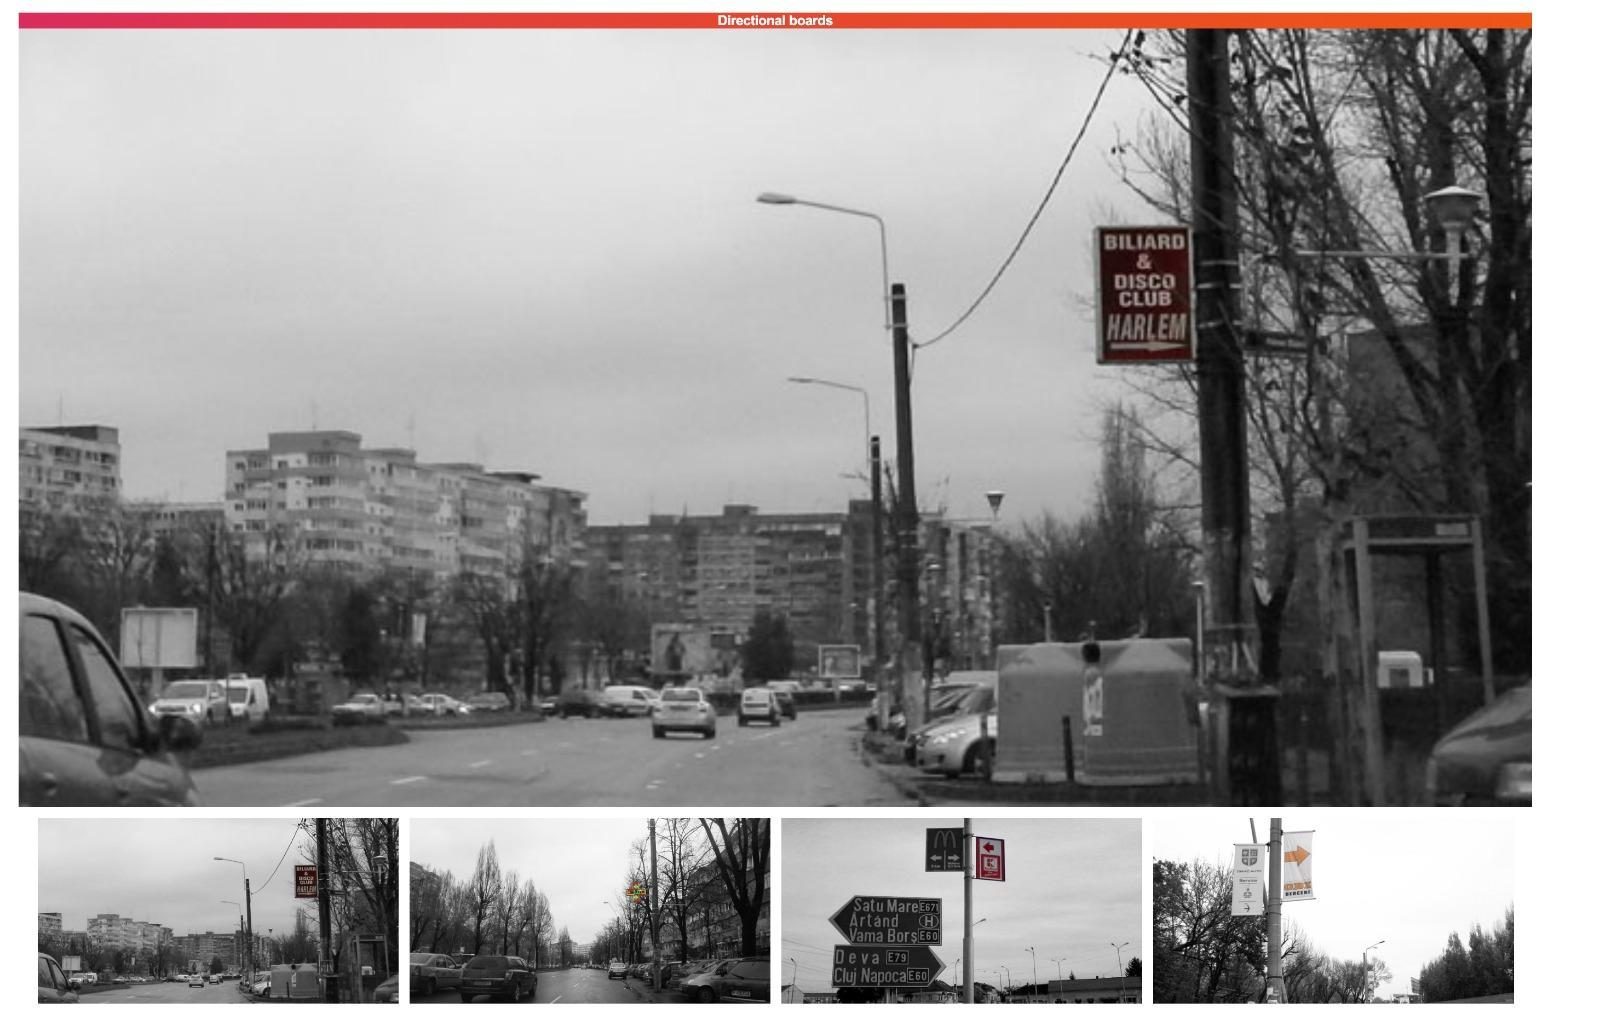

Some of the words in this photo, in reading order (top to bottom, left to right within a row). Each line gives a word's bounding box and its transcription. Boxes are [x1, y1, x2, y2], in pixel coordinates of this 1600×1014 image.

[1103, 233, 1186, 251] BILIARD
[1136, 253, 1153, 270] &
[1114, 273, 1177, 290] DISCO
[1119, 290, 1173, 307] CLUB
[1106, 313, 1187, 341] HARLEM
[853, 897, 885, 913] Satu
[886, 899, 919, 913] Mare
[919, 902, 939, 912] E671
[924, 915, 934, 927] H
[849, 927, 884, 943] Vama
[919, 930, 938, 941] E60
[835, 949, 880, 965] Deva
[887, 952, 907, 964] E79
[834, 967, 857, 986] Cluj
[860, 967, 907, 987] Napoca
[908, 970, 927, 981] E60
